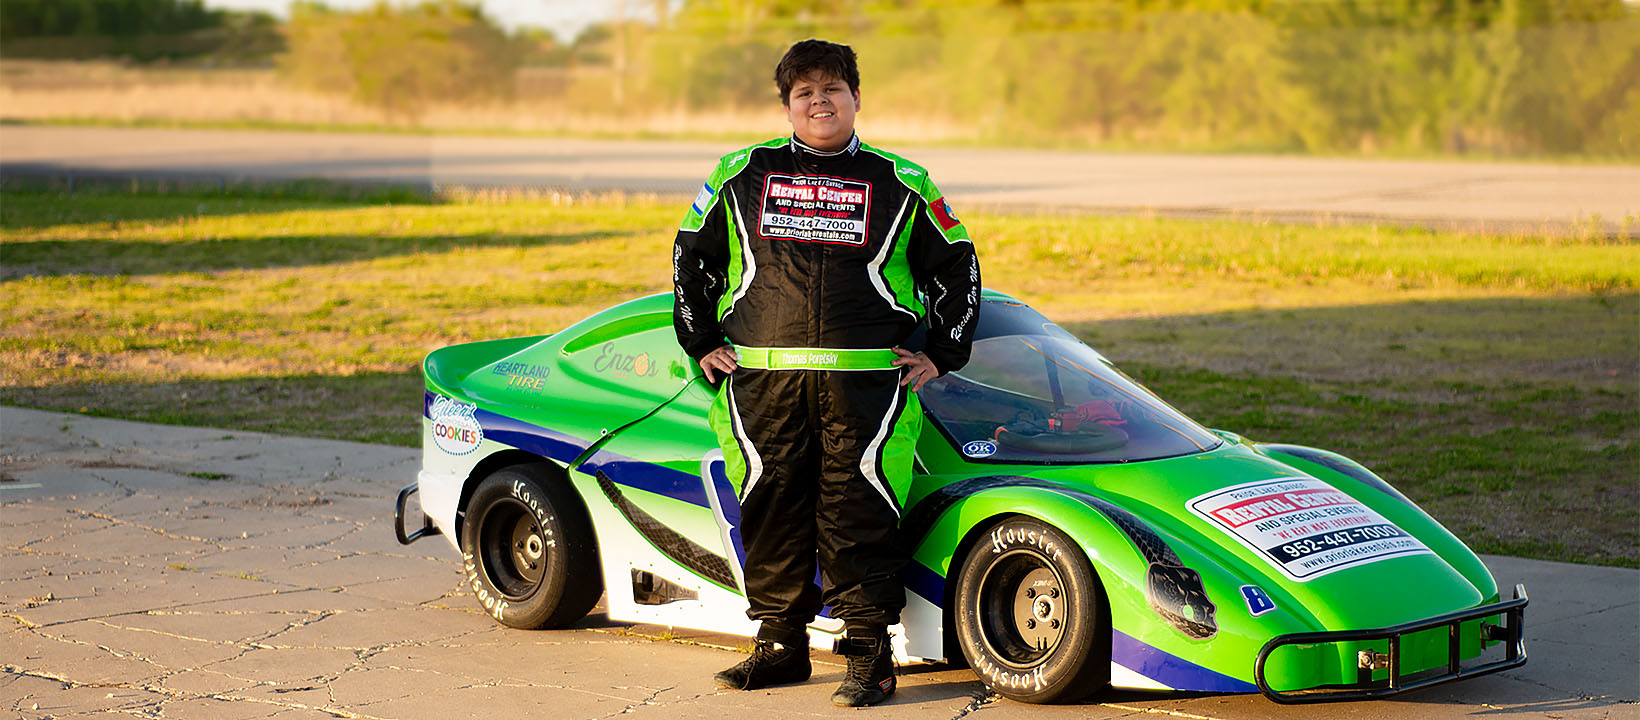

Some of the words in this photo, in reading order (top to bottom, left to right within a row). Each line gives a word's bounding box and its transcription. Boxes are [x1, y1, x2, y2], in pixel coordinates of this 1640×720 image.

[770, 184, 814, 200] RENTAL
[818, 187, 862, 203] CENTER
[793, 201, 825, 209] SPECIAL
[772, 216, 855, 230] 952-447-7000
[950, 307, 973, 342] Racing
[967, 285, 978, 305] For
[492, 362, 550, 378] HEARTLAND
[783, 353, 807, 365] Thomas
[508, 374, 546, 390] TIRE
[436, 424, 476, 444] COOKIES
[512, 480, 556, 548] Hoosier
[1216, 498, 1296, 525] RENTAL
[1255, 519, 1280, 532] AND
[1279, 510, 1327, 525] SPECIAL
[1324, 505, 1365, 516] EVENTS
[990, 526, 1062, 562] Hoosier
[1282, 525, 1399, 558] 952-447-7000
[1301, 540, 1416, 568] www.priorlakerentals.com
[464, 552, 509, 620] Hoosier
[1239, 584, 1277, 617] 8
[974, 655, 1047, 692] Hoosier
